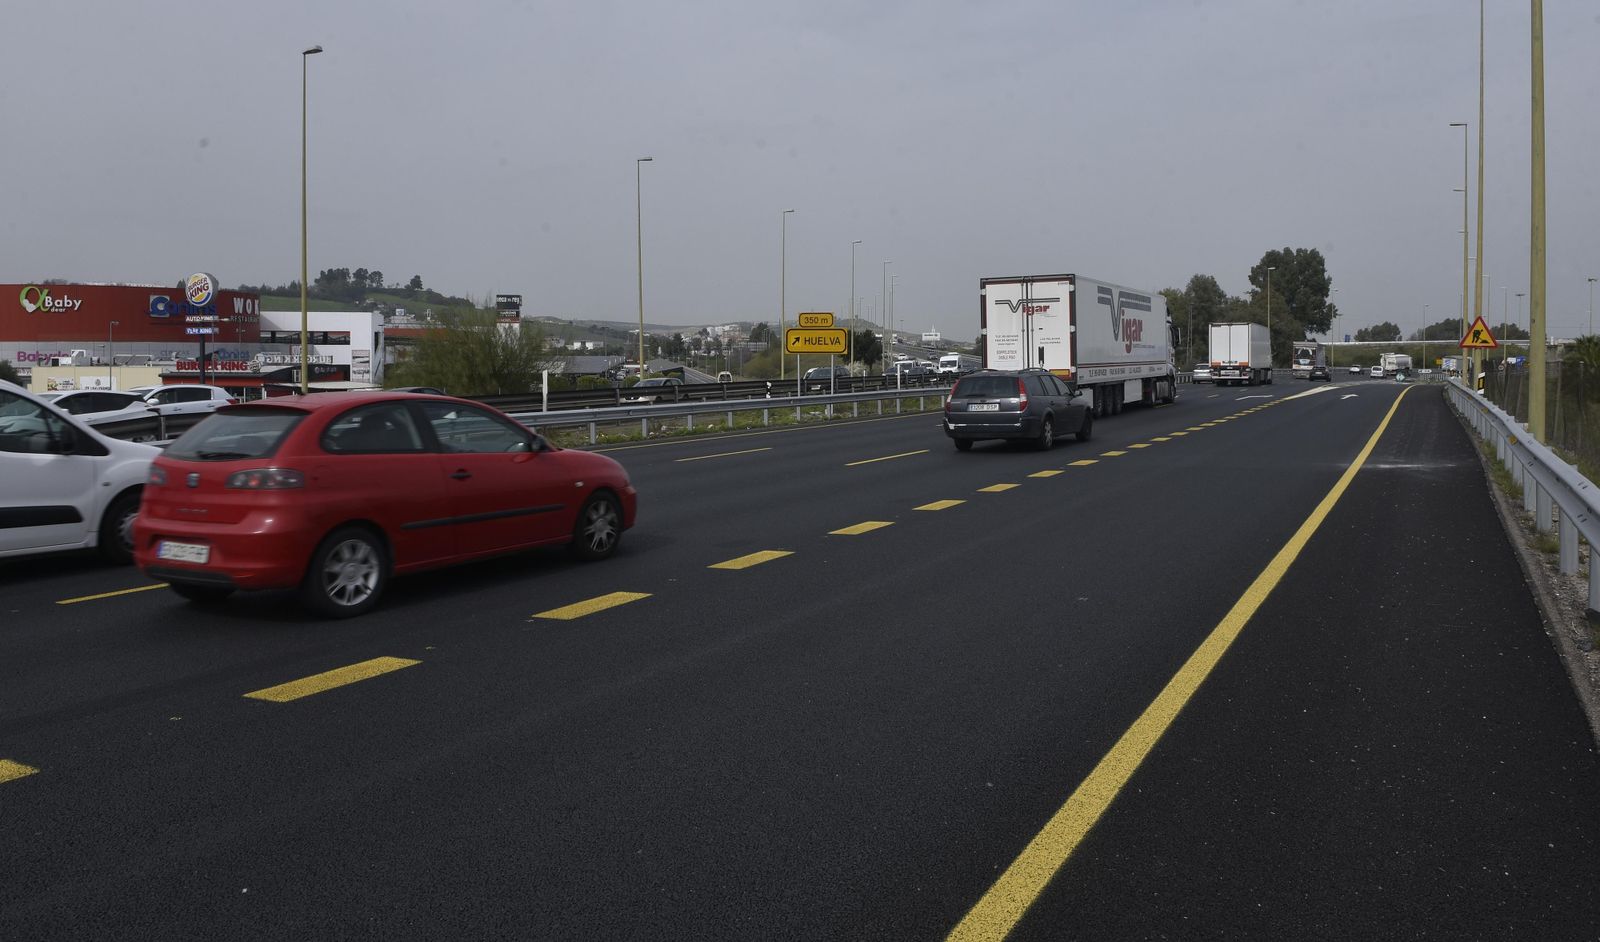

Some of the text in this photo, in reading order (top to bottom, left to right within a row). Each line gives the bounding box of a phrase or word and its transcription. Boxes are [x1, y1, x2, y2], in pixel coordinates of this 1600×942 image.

[189, 283, 209, 299] KING
[45, 295, 82, 310] Baby
[804, 336, 841, 345] HUELVA
[176, 360, 219, 371] BURER
[221, 360, 248, 371] KING
